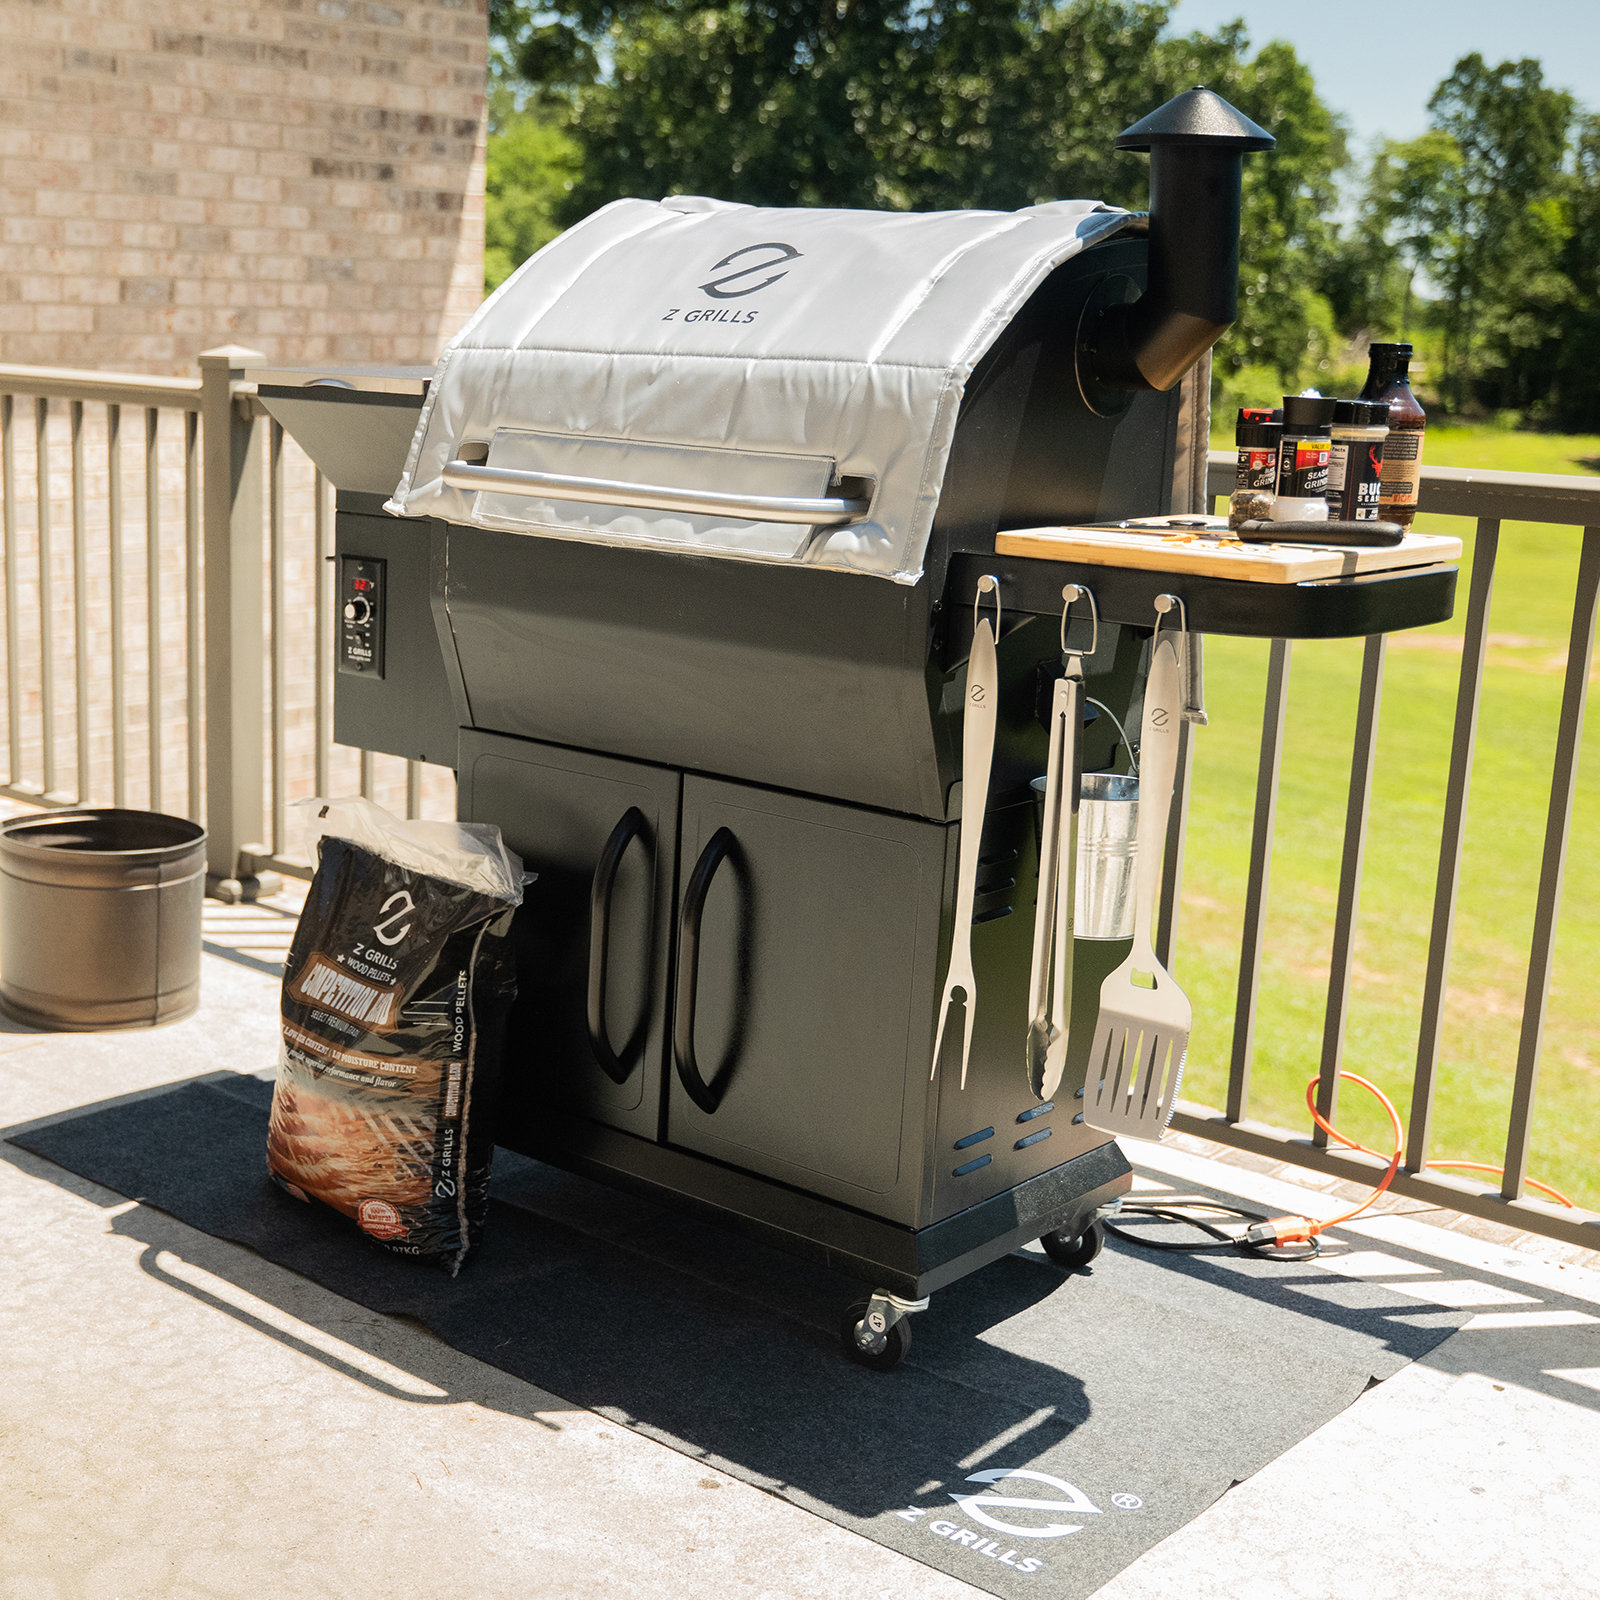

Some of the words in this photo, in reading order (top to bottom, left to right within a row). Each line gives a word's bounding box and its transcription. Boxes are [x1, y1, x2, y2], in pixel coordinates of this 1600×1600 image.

[661, 308, 680, 321] Z
[684, 309, 759, 324] GRILLS
[346, 957, 368, 975] WOOD
[366, 967, 392, 982] PELLETS
[352, 943, 365, 956] Z
[365, 949, 400, 970] GRILLS
[455, 969, 468, 1014] PELLETS
[452, 1016, 464, 1052] WOOD
[341, 1053, 379, 1069] MOISTURE
[379, 1061, 418, 1074] CONTENT
[360, 1073, 374, 1084] and
[373, 1075, 397, 1088] flavor
[442, 1128, 454, 1168] GRILLS
[873, 1315, 882, 1328] 47
[896, 1505, 928, 1522] Z
[929, 1520, 1043, 1573] GRILLS
